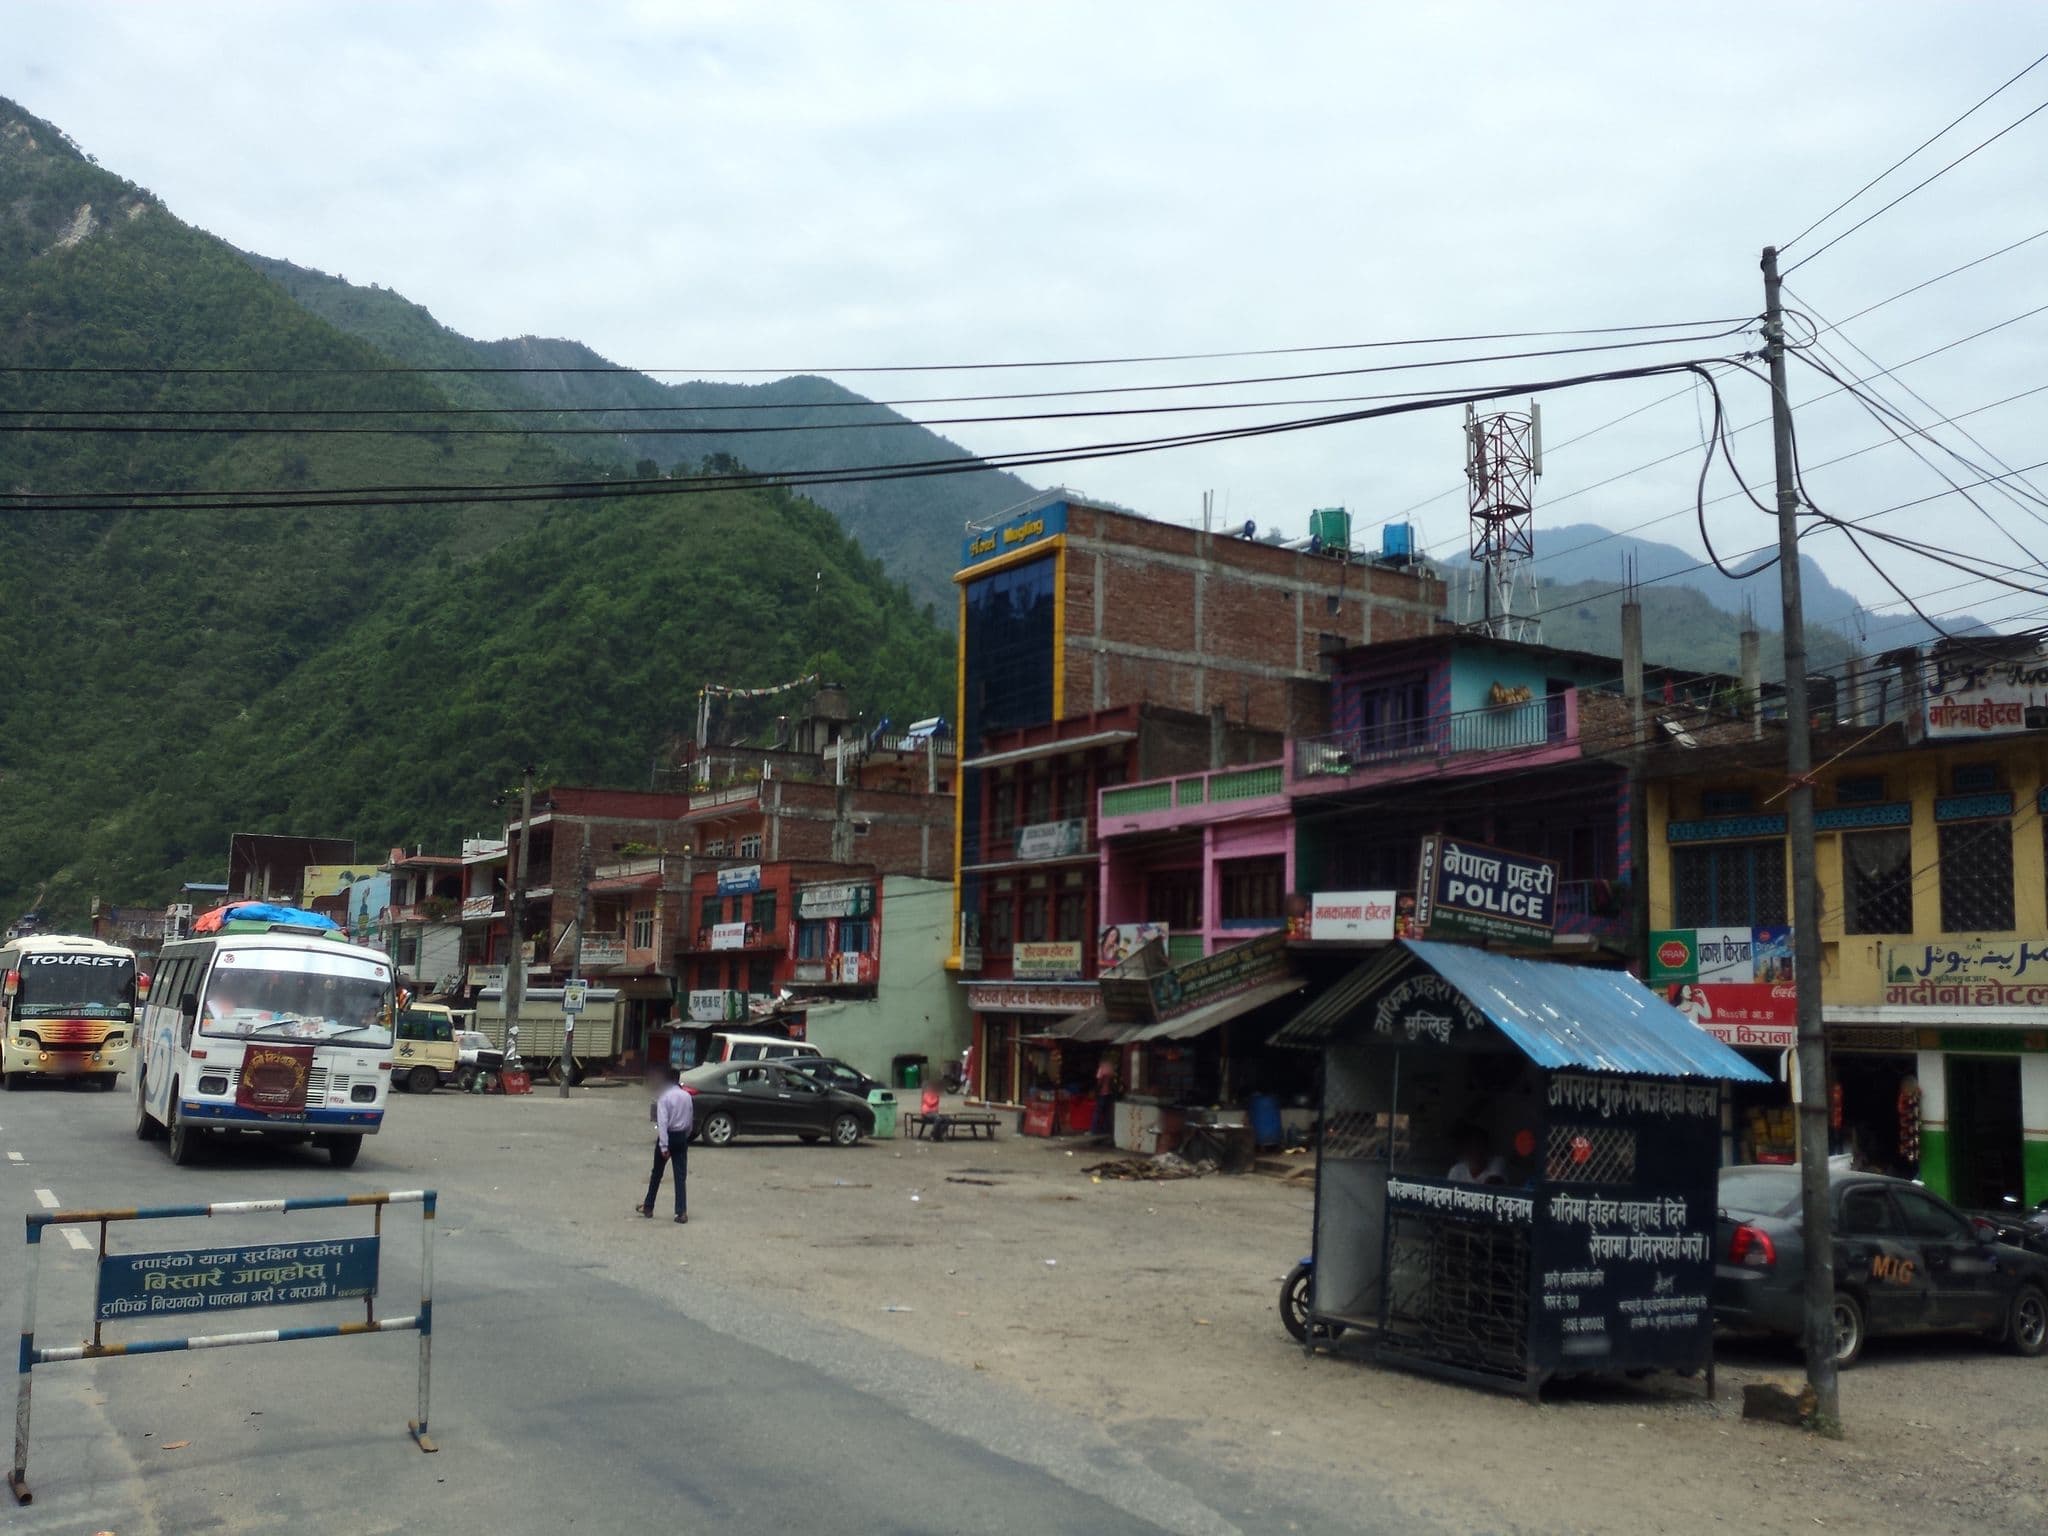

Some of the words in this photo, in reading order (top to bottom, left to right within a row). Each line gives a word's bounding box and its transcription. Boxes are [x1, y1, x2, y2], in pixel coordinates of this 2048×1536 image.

[1419, 841, 1434, 922] POLICE
[1443, 843, 1502, 884] नेपाल
[1507, 863, 1555, 896] प्रहरी
[1315, 905, 1363, 920] मनकामना
[1365, 900, 1392, 921] होटल
[1447, 879, 1544, 921] POLICE
[26, 955, 129, 968] TOURIST
[1660, 948, 1685, 960] PRAN
[1722, 935, 1753, 964] किराना
[1886, 978, 1970, 1006] मदीना
[1736, 1025, 1793, 1045] किराना
[199, 1251, 237, 1265] यात्रा
[242, 1248, 298, 1263] सुरक्षित
[304, 1243, 344, 1257] रहोस्
[144, 1269, 225, 1290] बिस्तारै
[232, 1262, 326, 1284] जानुहोस्
[151, 1293, 204, 1311] नियमको
[209, 1292, 248, 1306] पालना
